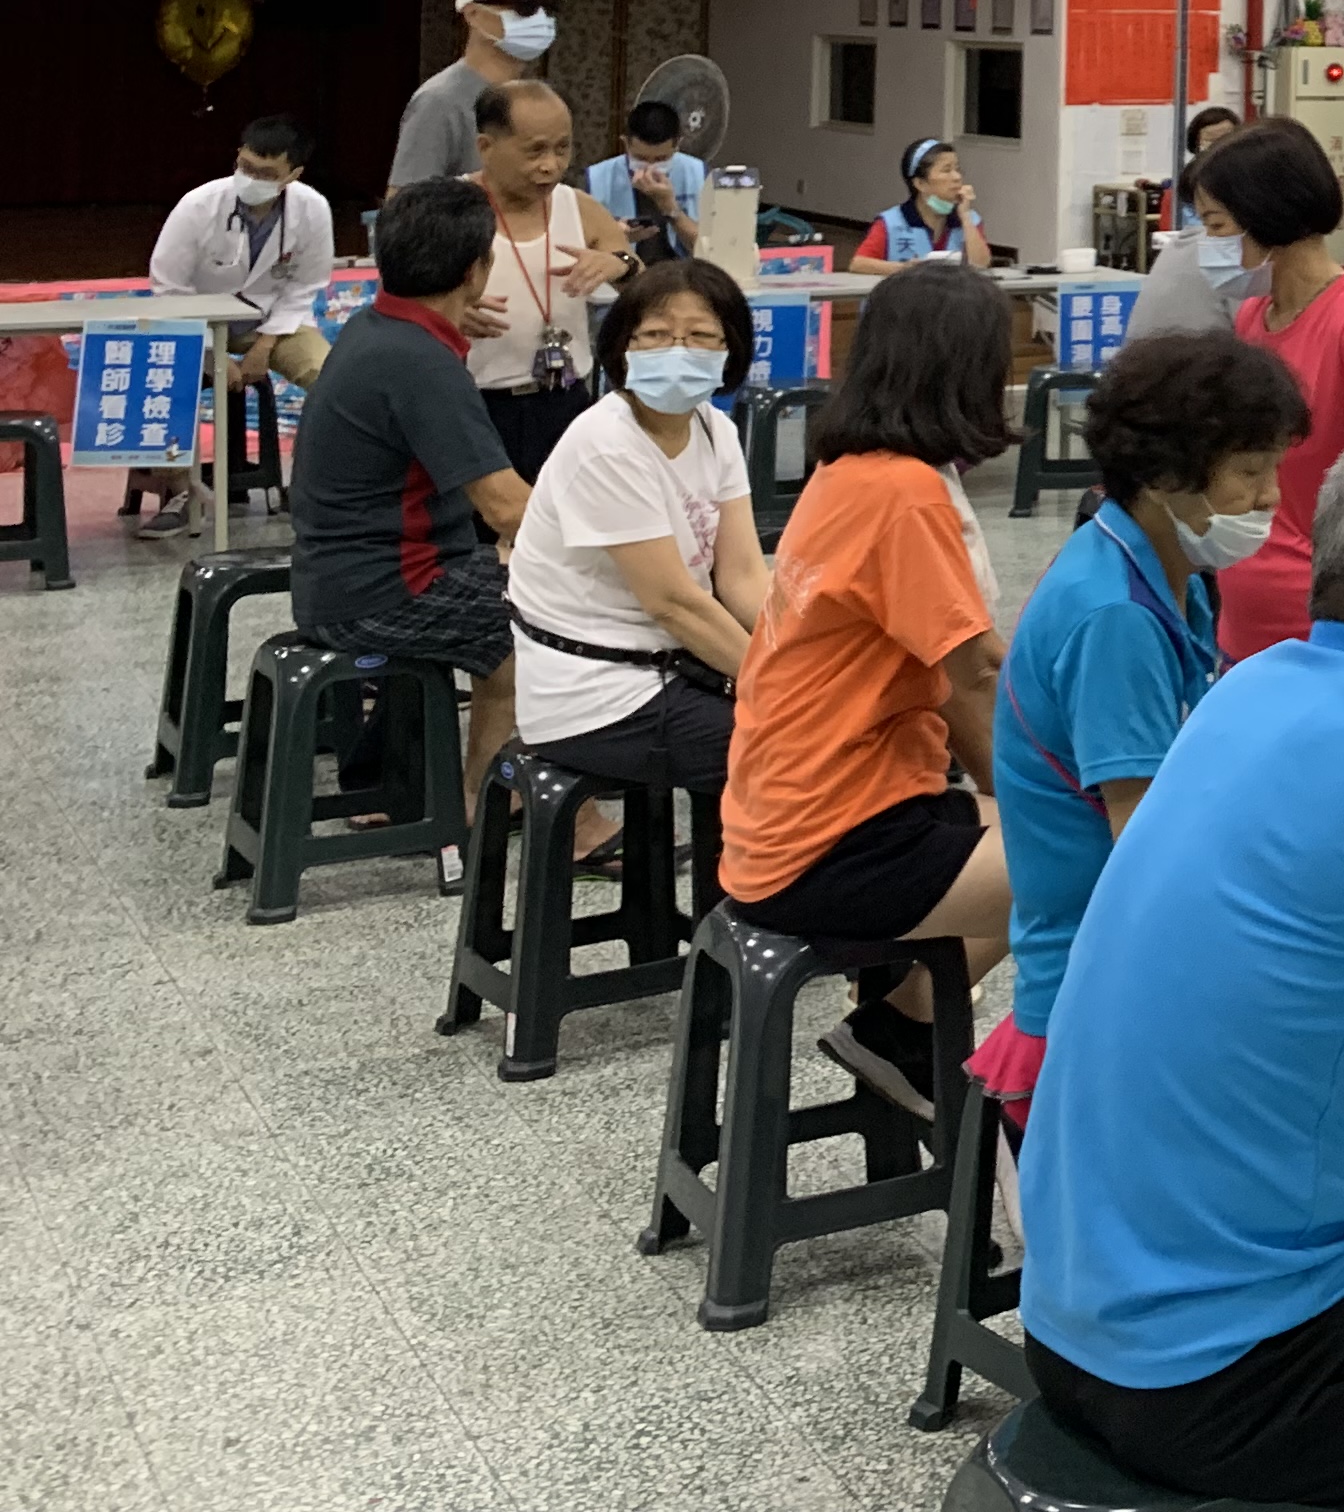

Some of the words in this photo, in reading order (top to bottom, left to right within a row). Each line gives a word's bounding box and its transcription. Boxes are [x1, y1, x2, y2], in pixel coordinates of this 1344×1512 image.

[95, 340, 134, 447] 醫師看診
[139, 340, 177, 447] 理學檢查
